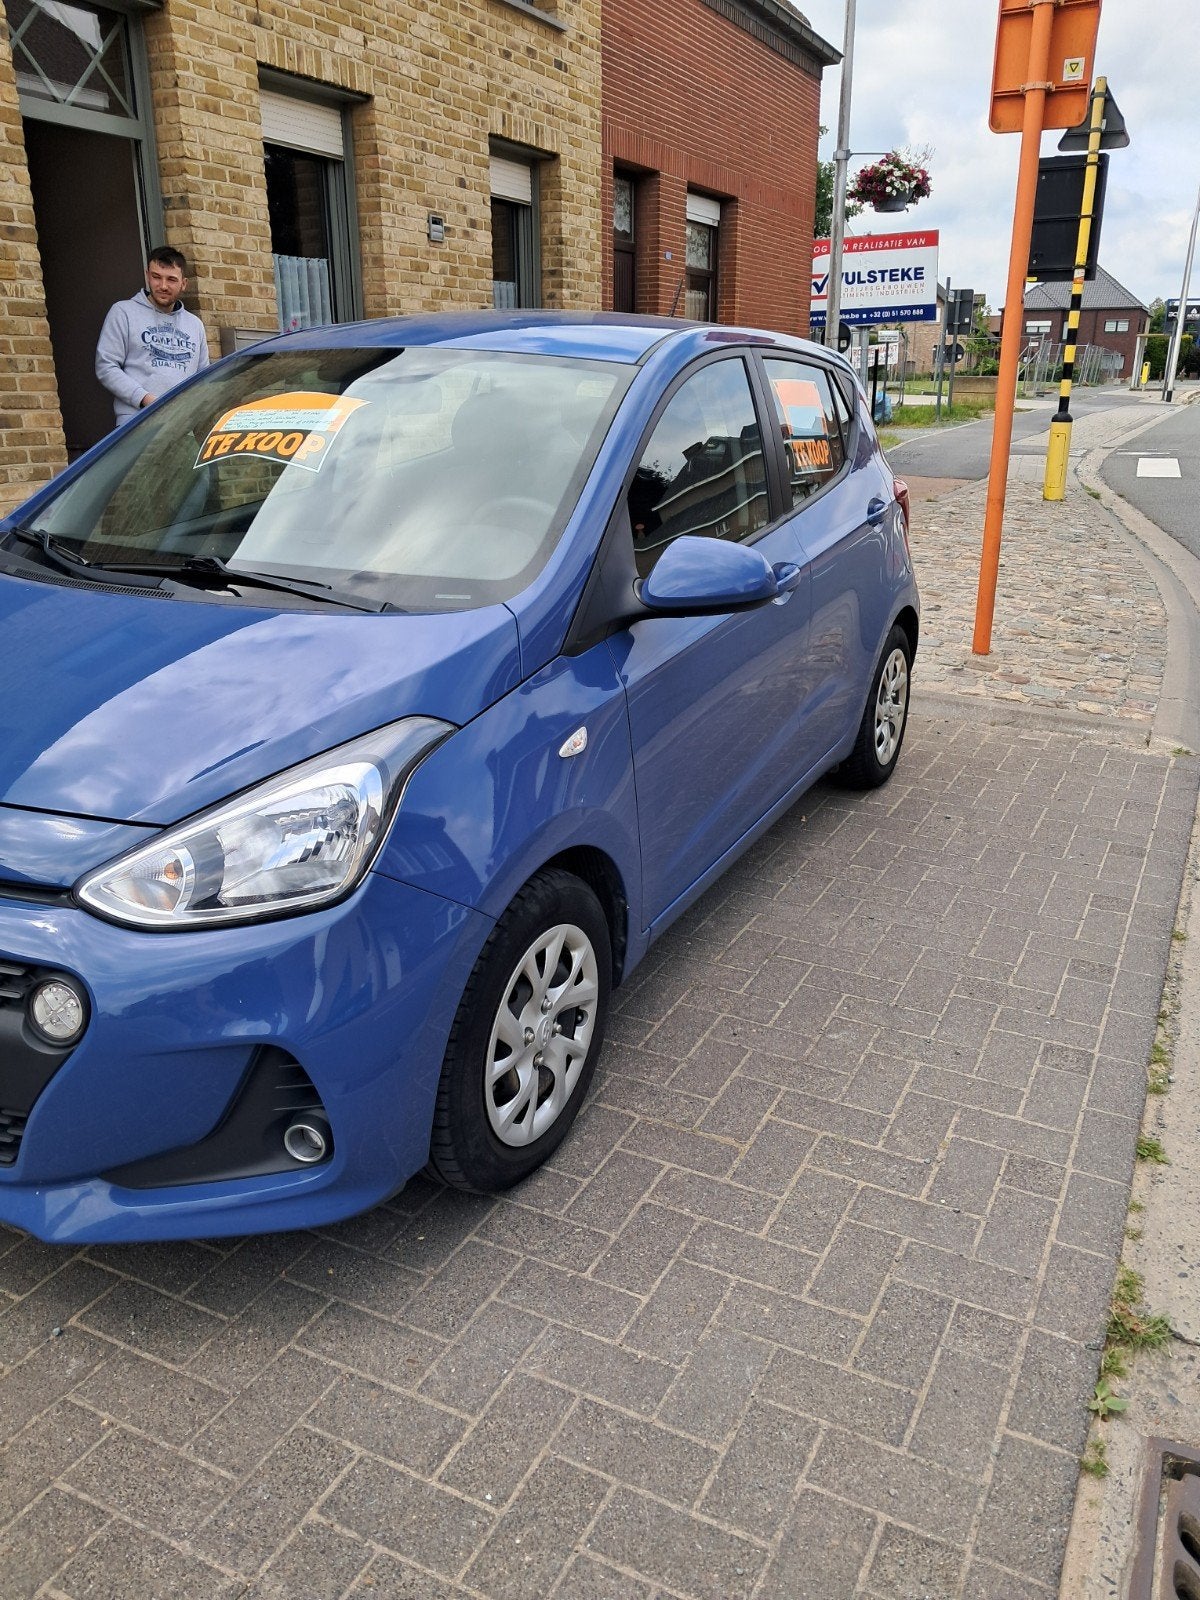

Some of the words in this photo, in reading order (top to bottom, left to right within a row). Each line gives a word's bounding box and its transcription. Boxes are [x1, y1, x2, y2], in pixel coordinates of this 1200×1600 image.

[852, 240, 903, 249] REALISATIE
[906, 238, 926, 246] VAN
[203, 434, 242, 460] TE
[235, 432, 326, 461] KOOP
[805, 438, 828, 465] KOOP
